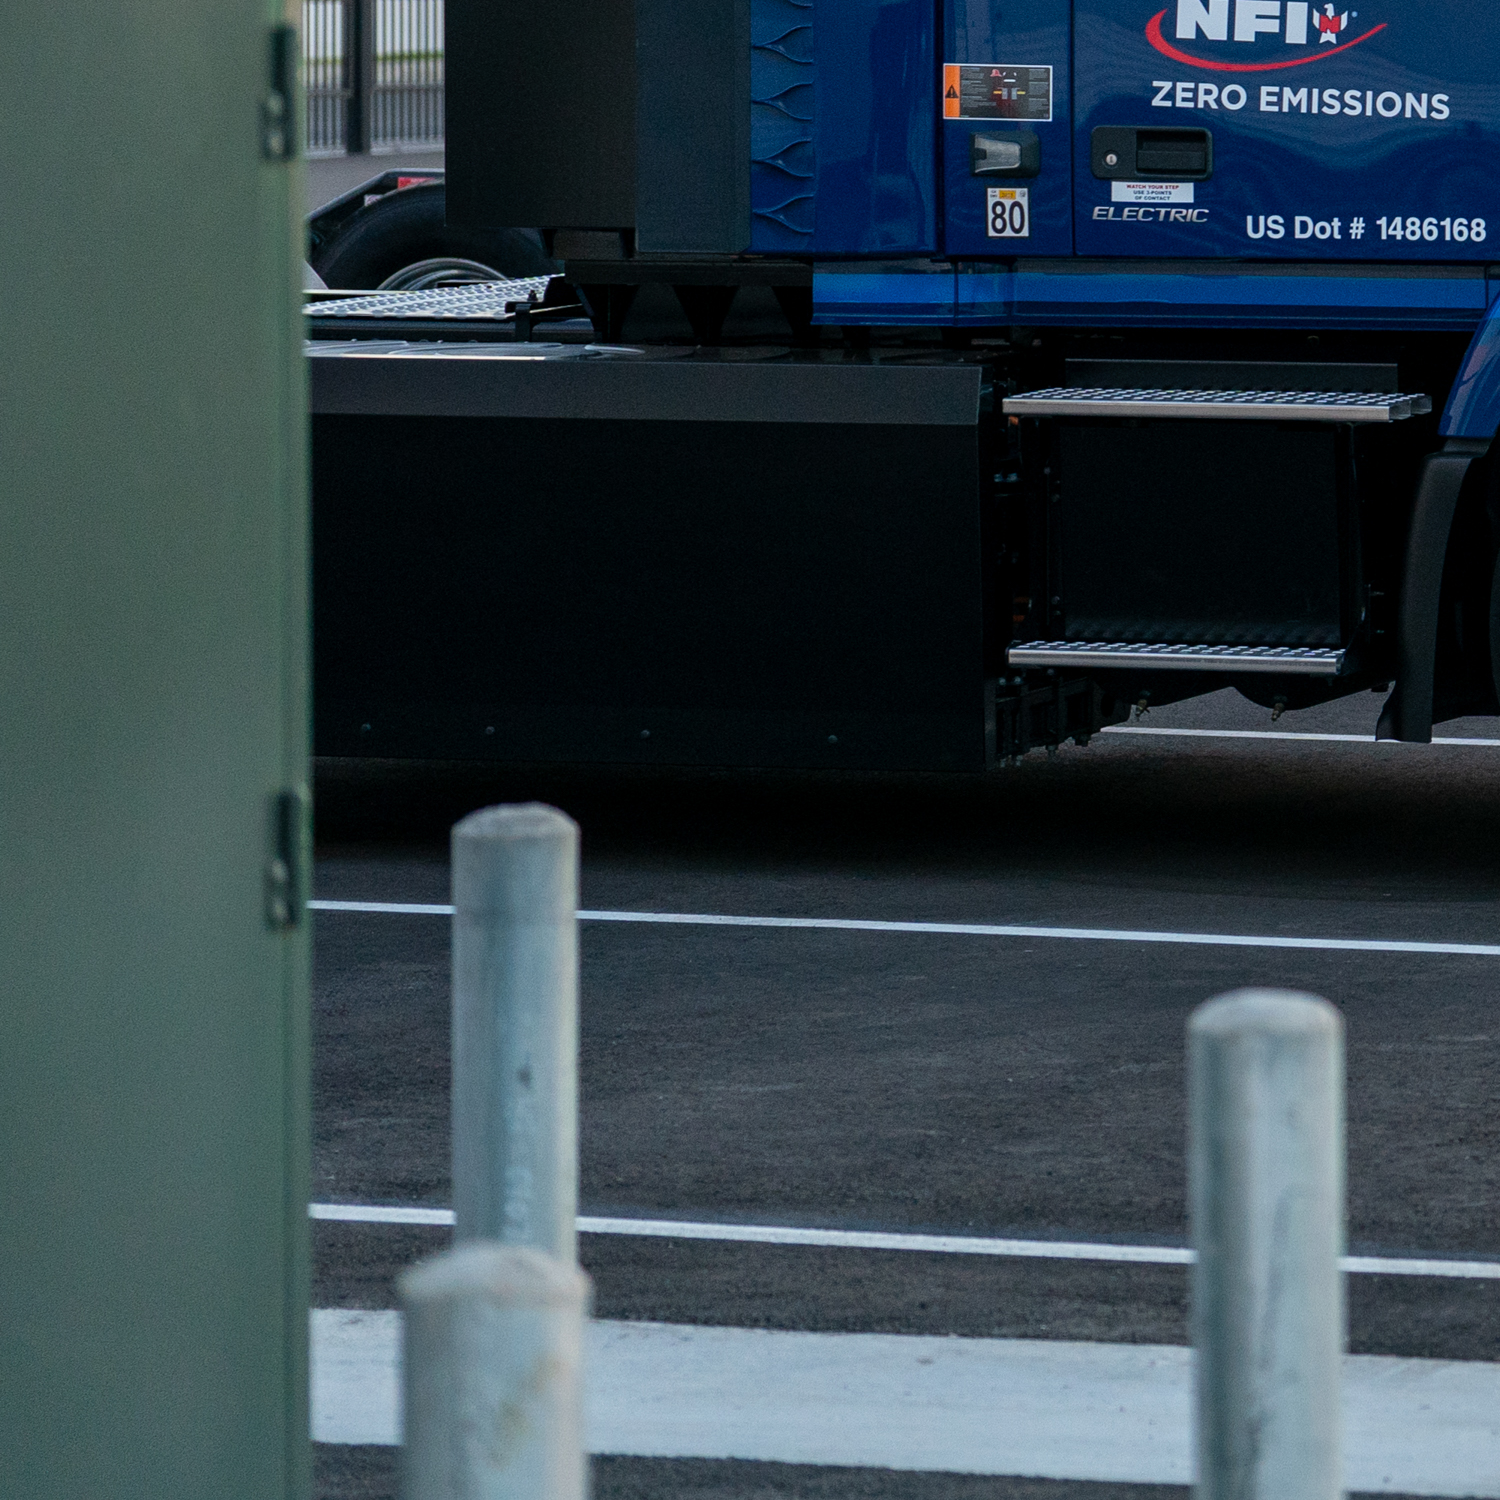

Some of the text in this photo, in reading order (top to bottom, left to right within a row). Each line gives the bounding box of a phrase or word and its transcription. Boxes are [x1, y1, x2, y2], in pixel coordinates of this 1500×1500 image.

[1151, 80, 1450, 120] ZERO EMISSIONS
[991, 200, 1026, 234] 80
[1092, 206, 1210, 223] ELECTRIC
[1246, 214, 1487, 243] US Dot # 1486168
